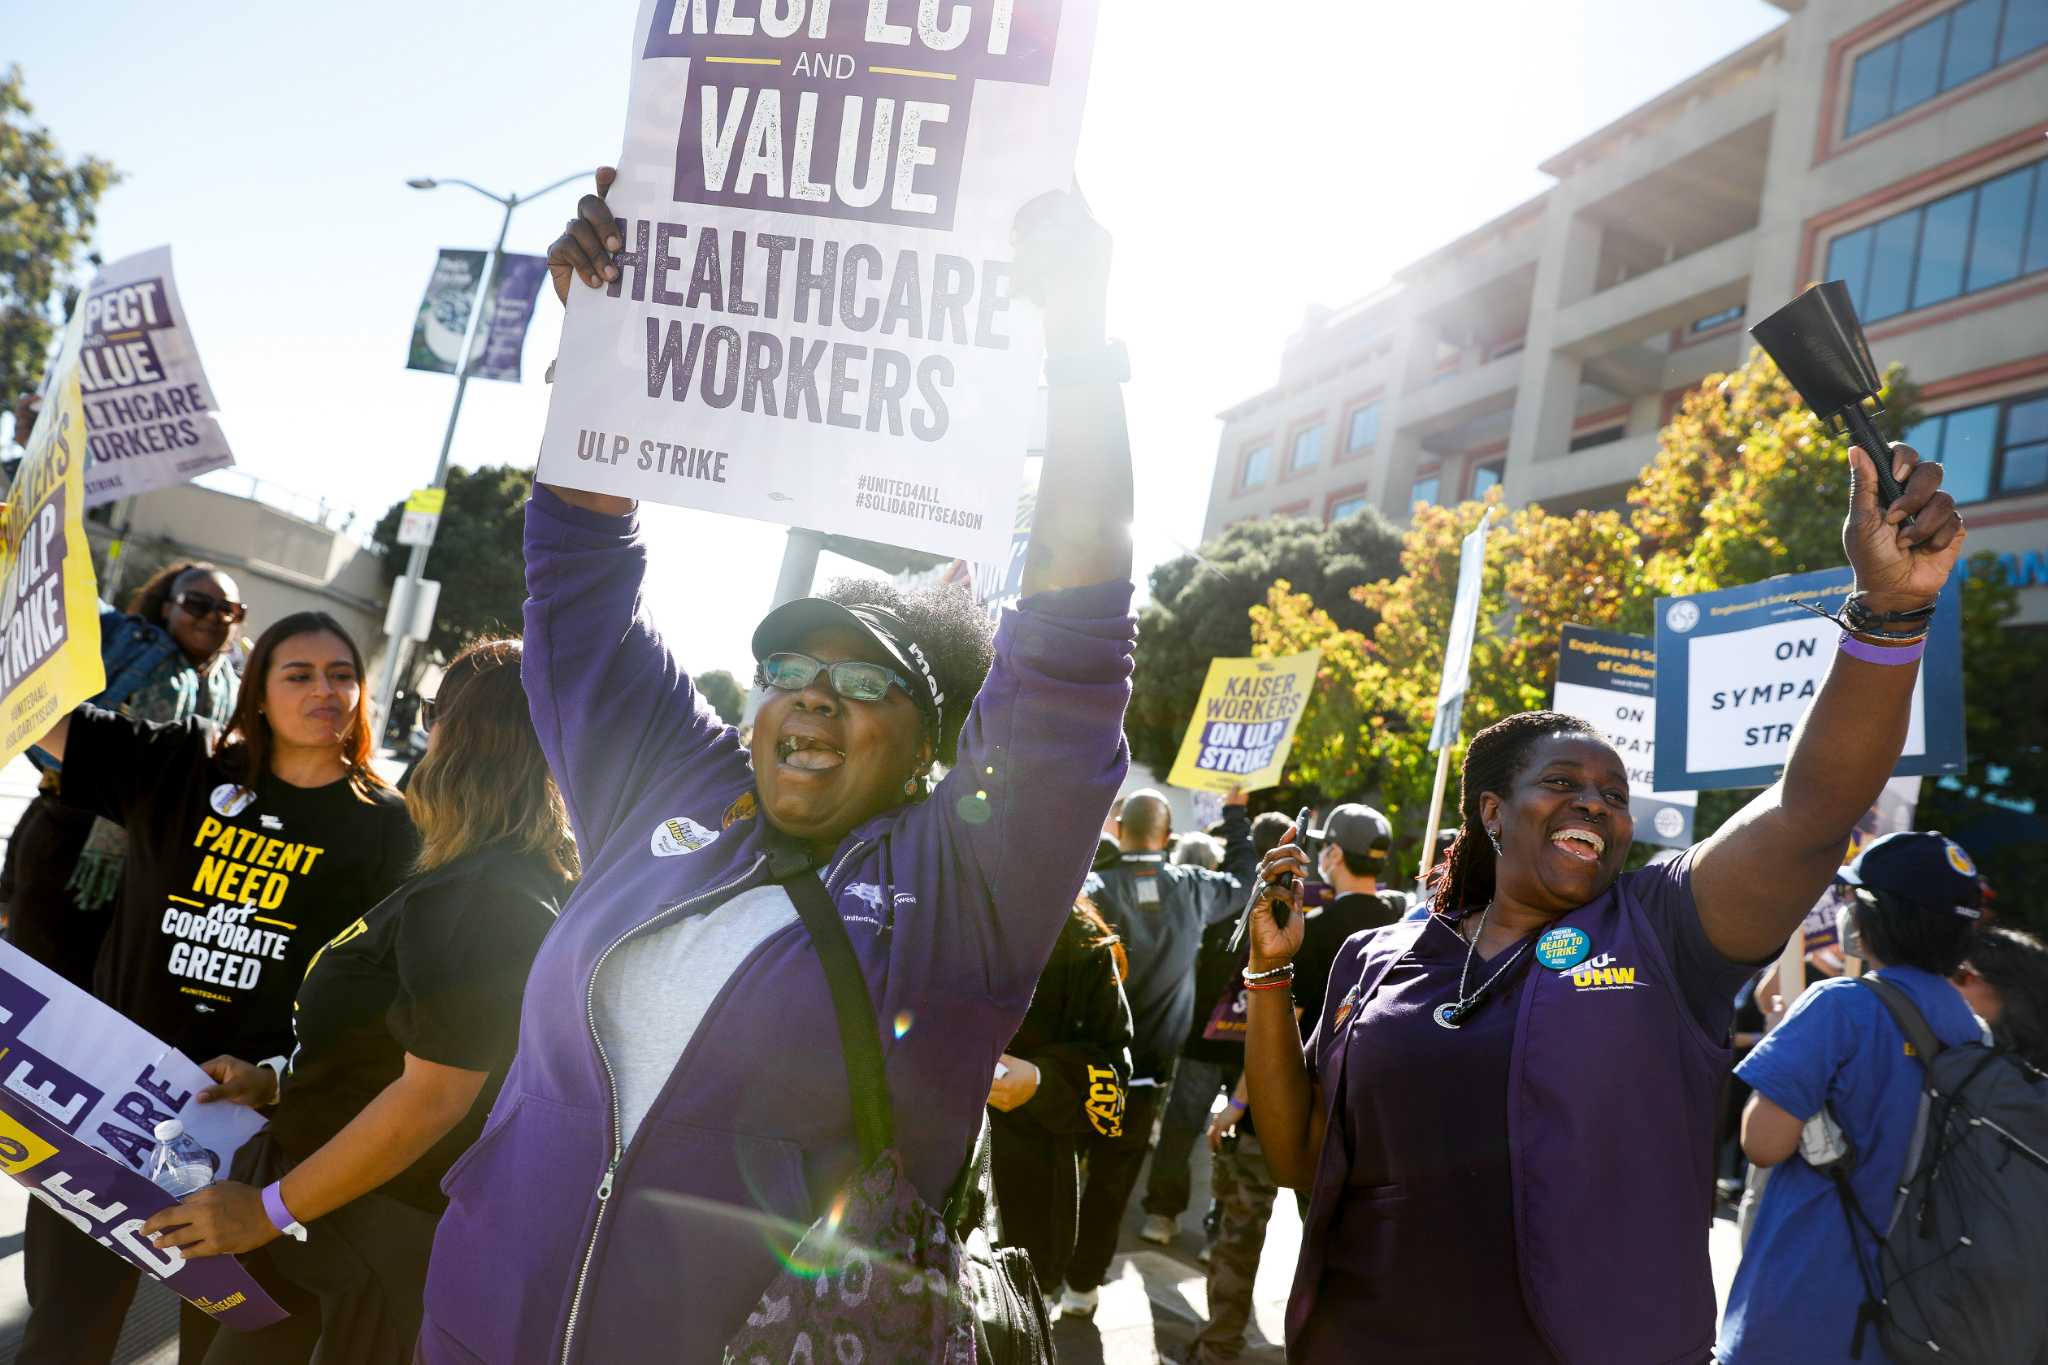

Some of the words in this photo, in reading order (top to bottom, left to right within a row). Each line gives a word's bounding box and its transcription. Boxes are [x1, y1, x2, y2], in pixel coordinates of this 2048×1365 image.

[792, 51, 856, 80] AND
[700, 86, 951, 215] VALUE
[607, 218, 1012, 349] HEALTHCARE
[646, 317, 956, 442] WORKERS
[577, 429, 629, 466] ULP
[637, 440, 729, 483] STRIKE
[858, 474, 940, 503] #UNITED4ALL
[856, 492, 983, 530] #SOLIDARITYSEASON
[0, 572, 64, 695] TRIKE
[1776, 638, 1816, 660] ON
[1225, 673, 1296, 698] KAISER
[1207, 693, 1301, 720] WORKERS
[1616, 707, 1644, 722] ON
[1208, 722, 1243, 747] ON
[1243, 721, 1283, 748] ULP
[1200, 743, 1273, 774] STRIKE
[193, 815, 325, 875] PATIENT
[192, 855, 289, 910] NEED
[206, 898, 258, 923] not
[161, 907, 290, 961] CORPORATE
[1541, 939, 1568, 951] READY
[1571, 937, 1583, 945] TO
[168, 942, 262, 990] GREED
[1546, 945, 1577, 959] STRIKE
[1573, 968, 1635, 987] UHW
